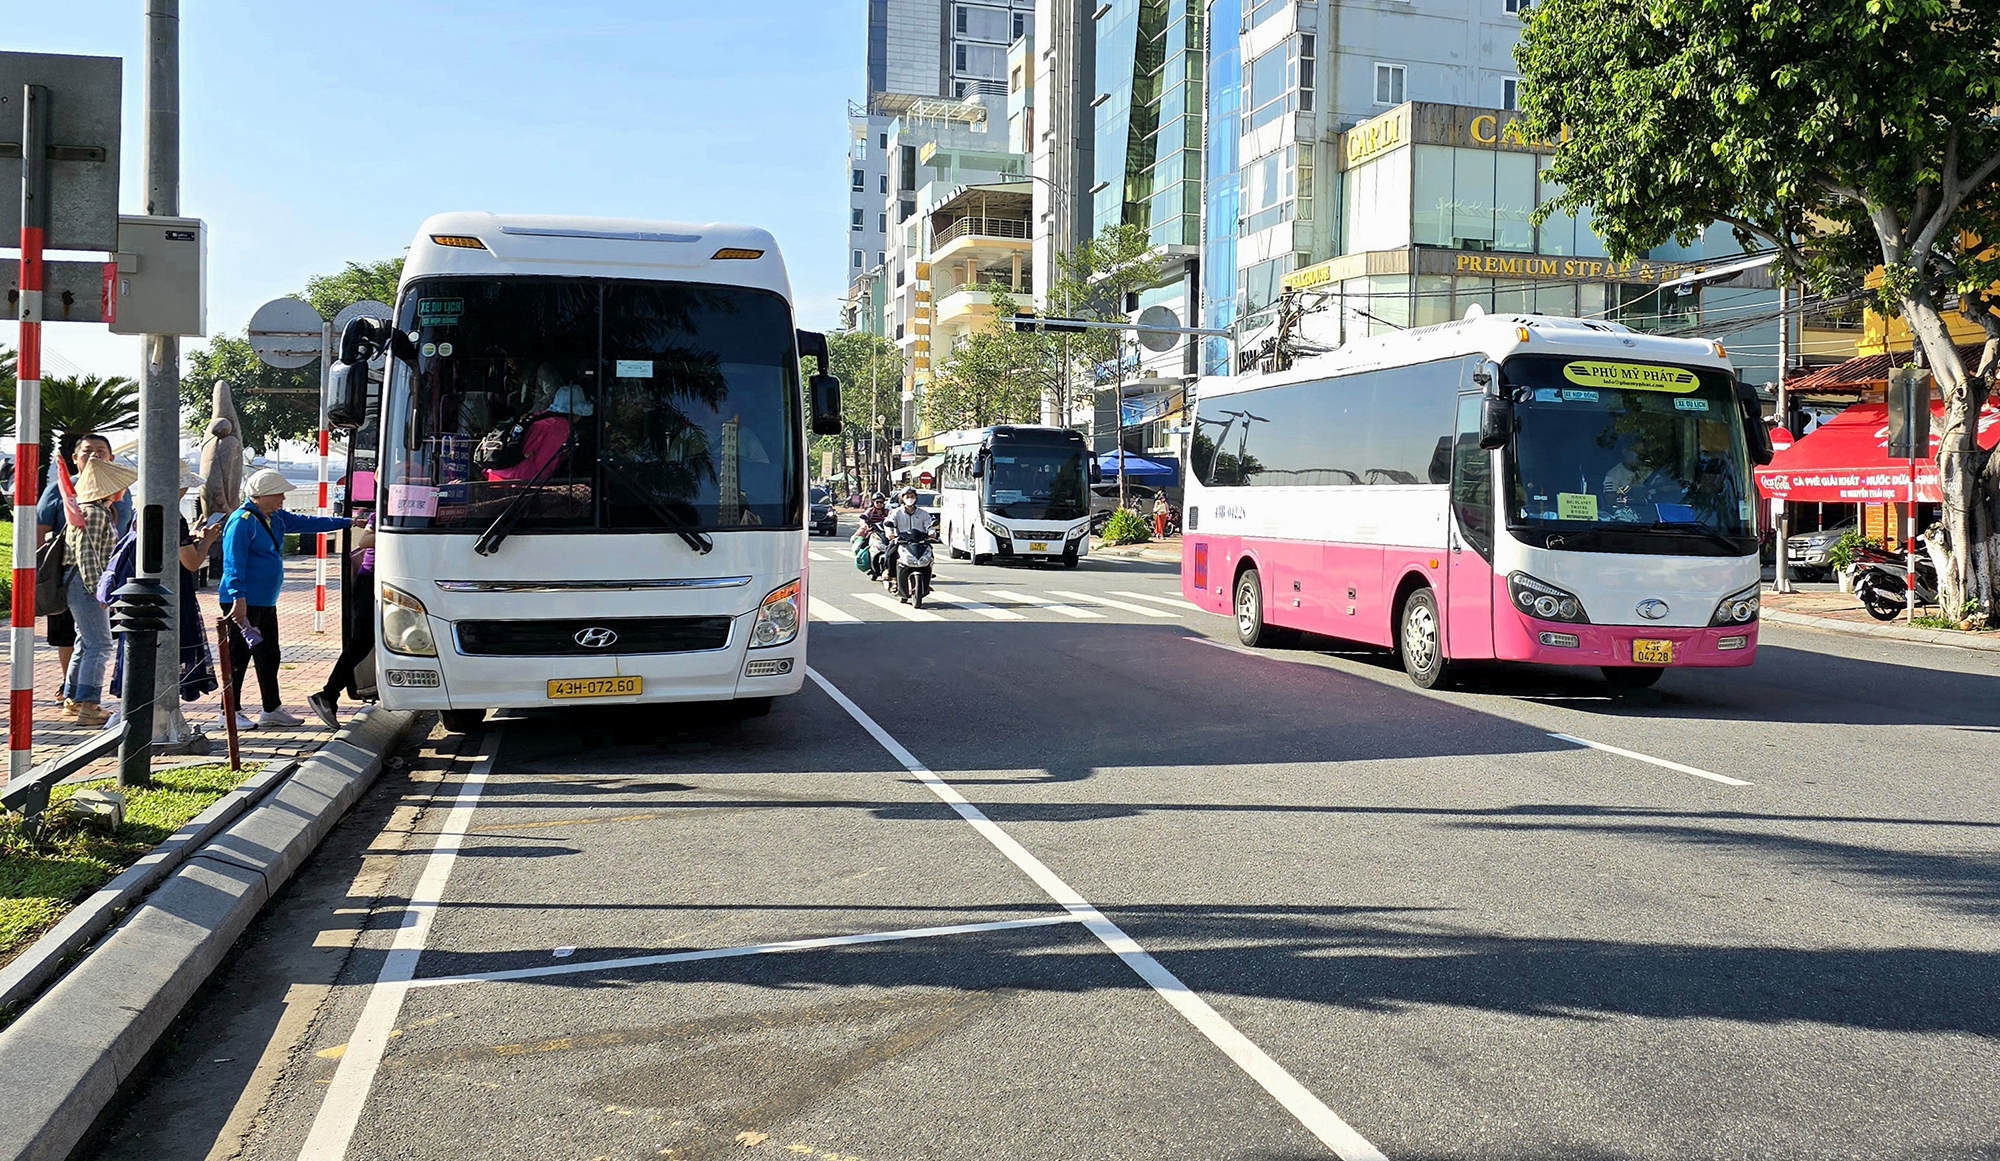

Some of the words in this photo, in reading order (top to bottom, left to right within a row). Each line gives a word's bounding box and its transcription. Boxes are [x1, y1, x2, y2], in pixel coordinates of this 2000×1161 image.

[1347, 114, 1402, 162] CARDI
[1456, 254, 1558, 276] PREMIUM
[1563, 260, 1632, 279] STEAK
[1639, 263, 1655, 281] &
[421, 302, 430, 312] XE
[432, 302, 442, 312] DU
[444, 301, 461, 313] LỊCH
[1592, 366, 1617, 378] PHÚ
[1622, 367, 1640, 379] MỸ
[1644, 370, 1675, 383] PHÁT
[1793, 476, 1804, 486] CÀ
[1805, 475, 1821, 486] PHÊ
[1839, 475, 1860, 486] KHÁT
[1866, 474, 1891, 485] NƯỚC
[1638, 651, 1669, 662] 042.28
[556, 680, 634, 695] 43H-072.60
